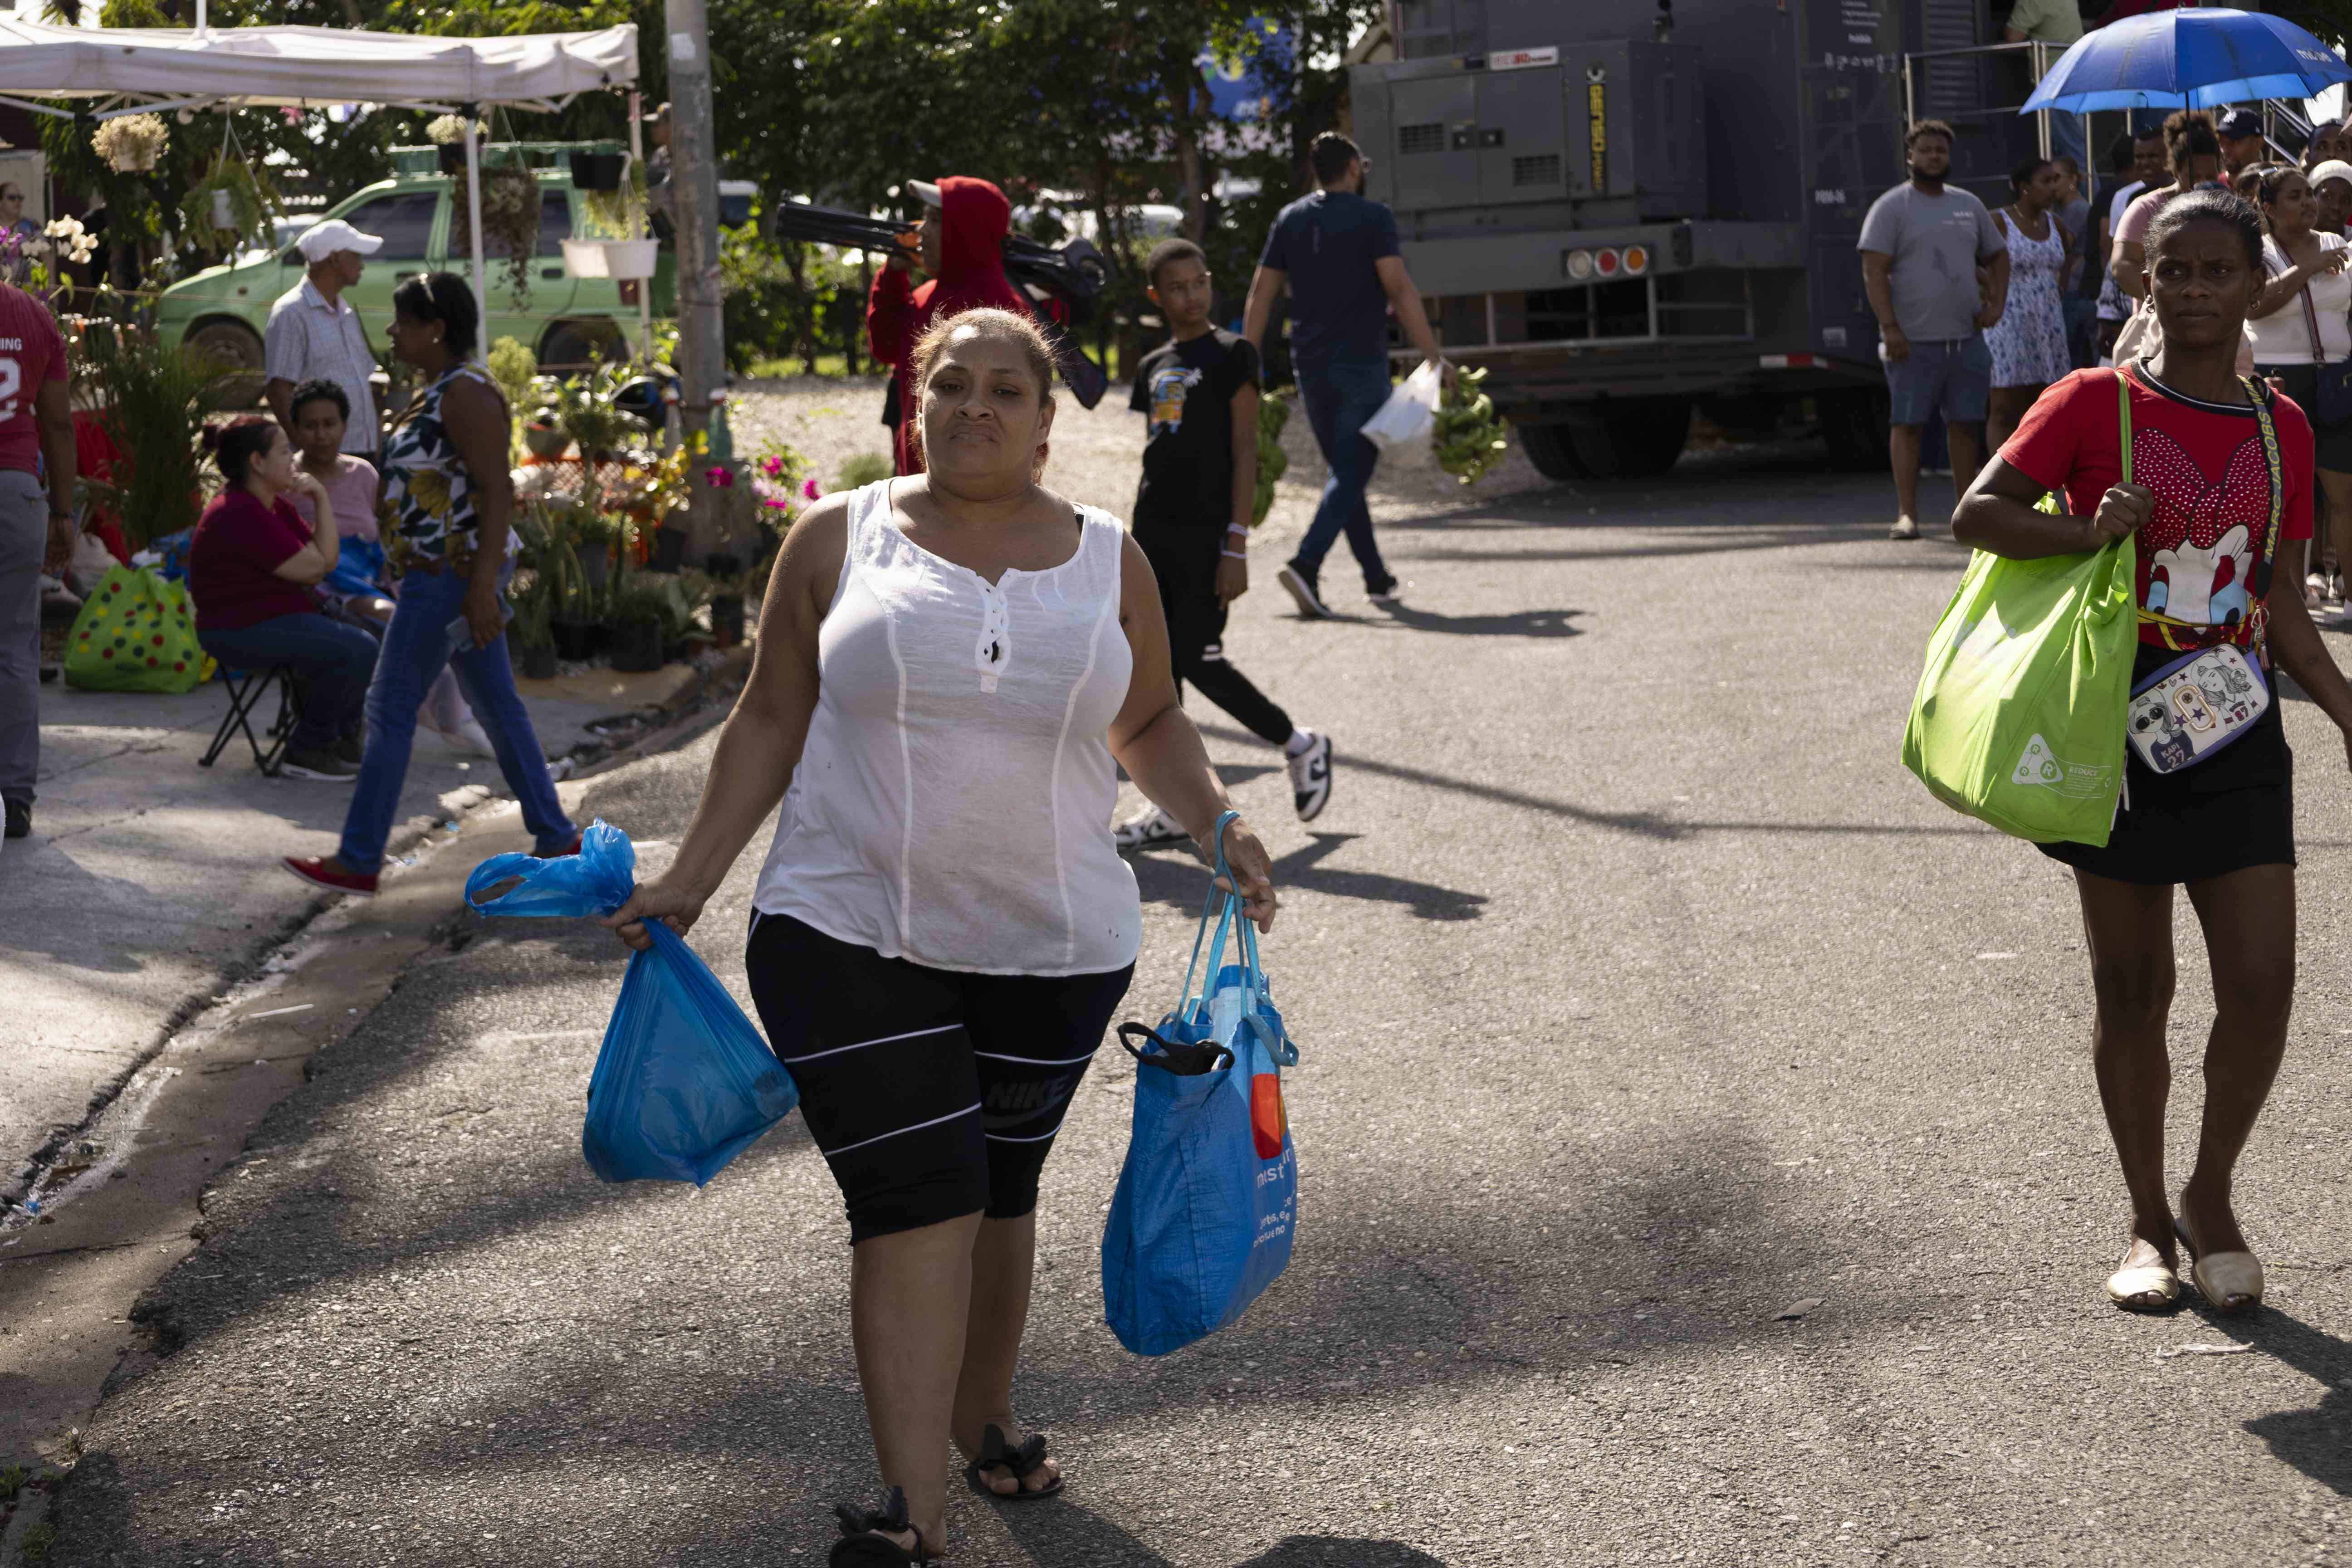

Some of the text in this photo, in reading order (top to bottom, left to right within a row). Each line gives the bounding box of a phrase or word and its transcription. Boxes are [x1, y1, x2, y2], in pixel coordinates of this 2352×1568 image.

[0, 337, 22, 351] ING
[2258, 411, 2282, 489] JACOBS
[2264, 493, 2281, 557] MARC
[2235, 706, 2249, 721] 87
[2167, 749, 2185, 768] 27
[2068, 766, 2098, 777] REDUCE
[986, 1074, 1070, 1110] NIKE
